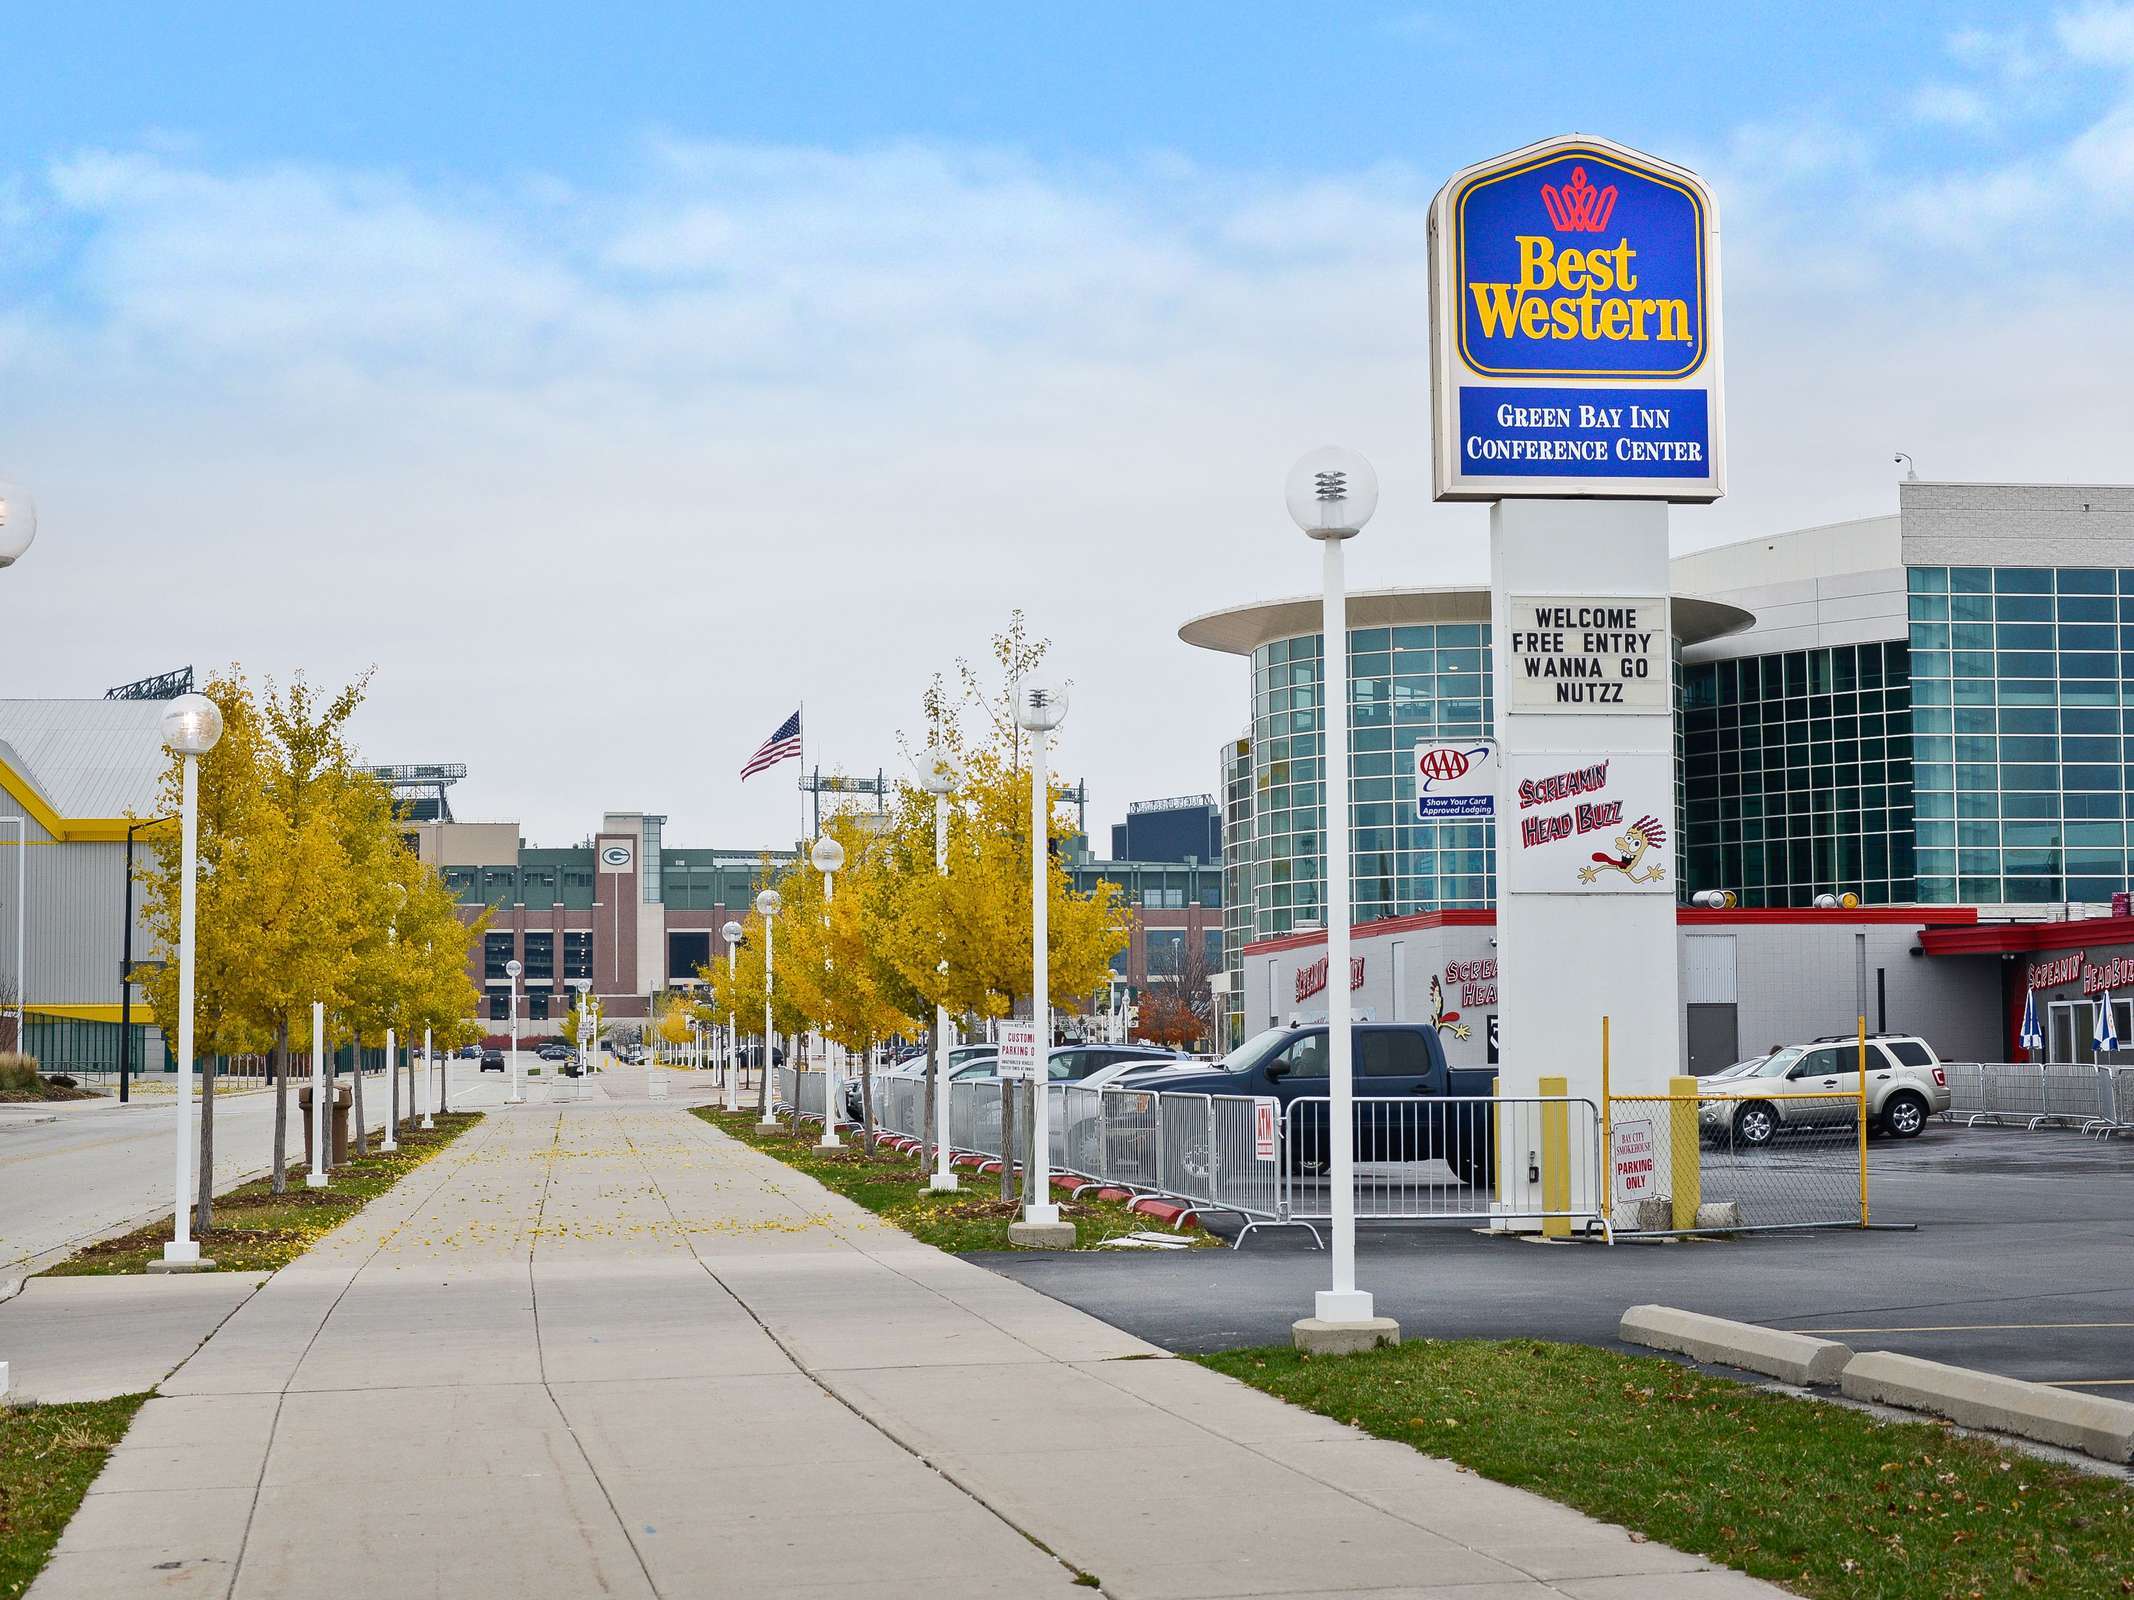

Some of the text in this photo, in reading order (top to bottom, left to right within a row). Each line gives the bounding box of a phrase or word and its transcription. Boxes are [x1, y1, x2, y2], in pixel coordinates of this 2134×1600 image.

[1515, 235, 1637, 292] Best
[1469, 276, 1693, 341] Western
[1496, 404, 1670, 429] GREEN BAY INN
[1466, 436, 1703, 462] CONFERENCE CENTER
[1535, 607, 1637, 629] WELCOME
[1512, 632, 1652, 653] FREE ENTRY
[1524, 657, 1649, 678] WANNA GO
[1556, 682, 1624, 703] NUTZZ
[1426, 749, 1464, 779] AAA
[1518, 759, 1610, 809] SCREAMIN'
[1423, 805, 1492, 816] Approved Lodging
[1426, 797, 1487, 806] Show Your Card
[1521, 800, 1624, 849] HEAD BUZZ
[602, 847, 630, 865] G
[1462, 982, 1498, 1008] HEA
[1002, 1046, 1028, 1056] PARKING
[1257, 1108, 1272, 1141] ATM
[1622, 1132, 1644, 1143] BAY CITY
[1616, 1142, 1651, 1155] SMOKEHOUSE
[1617, 1158, 1653, 1175] PARKING
[1625, 1175, 1646, 1190] ONLY
